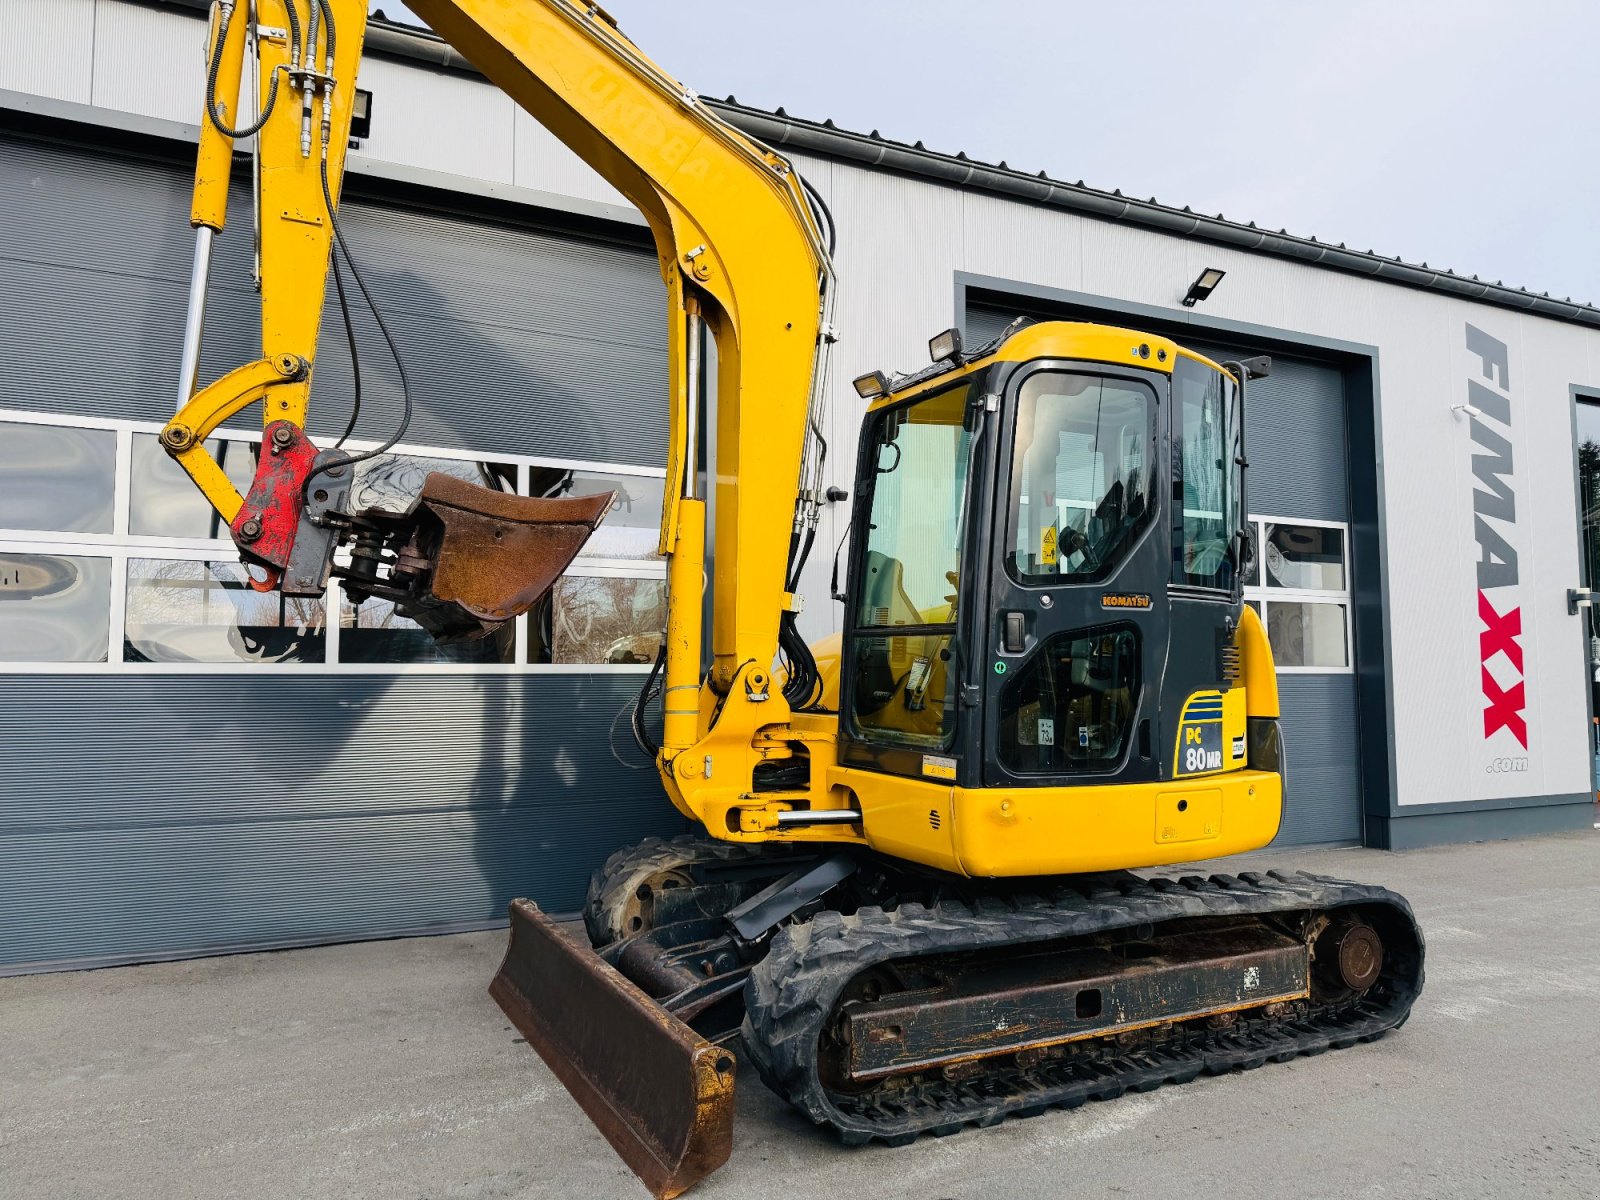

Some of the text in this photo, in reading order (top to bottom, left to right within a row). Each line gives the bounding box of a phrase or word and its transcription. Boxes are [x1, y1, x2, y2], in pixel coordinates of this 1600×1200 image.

[1465, 321, 1528, 752] FIMAXX
[1102, 595, 1149, 608] KOMATSU
[1186, 727, 1202, 745] PC
[1485, 757, 1529, 774] .com
